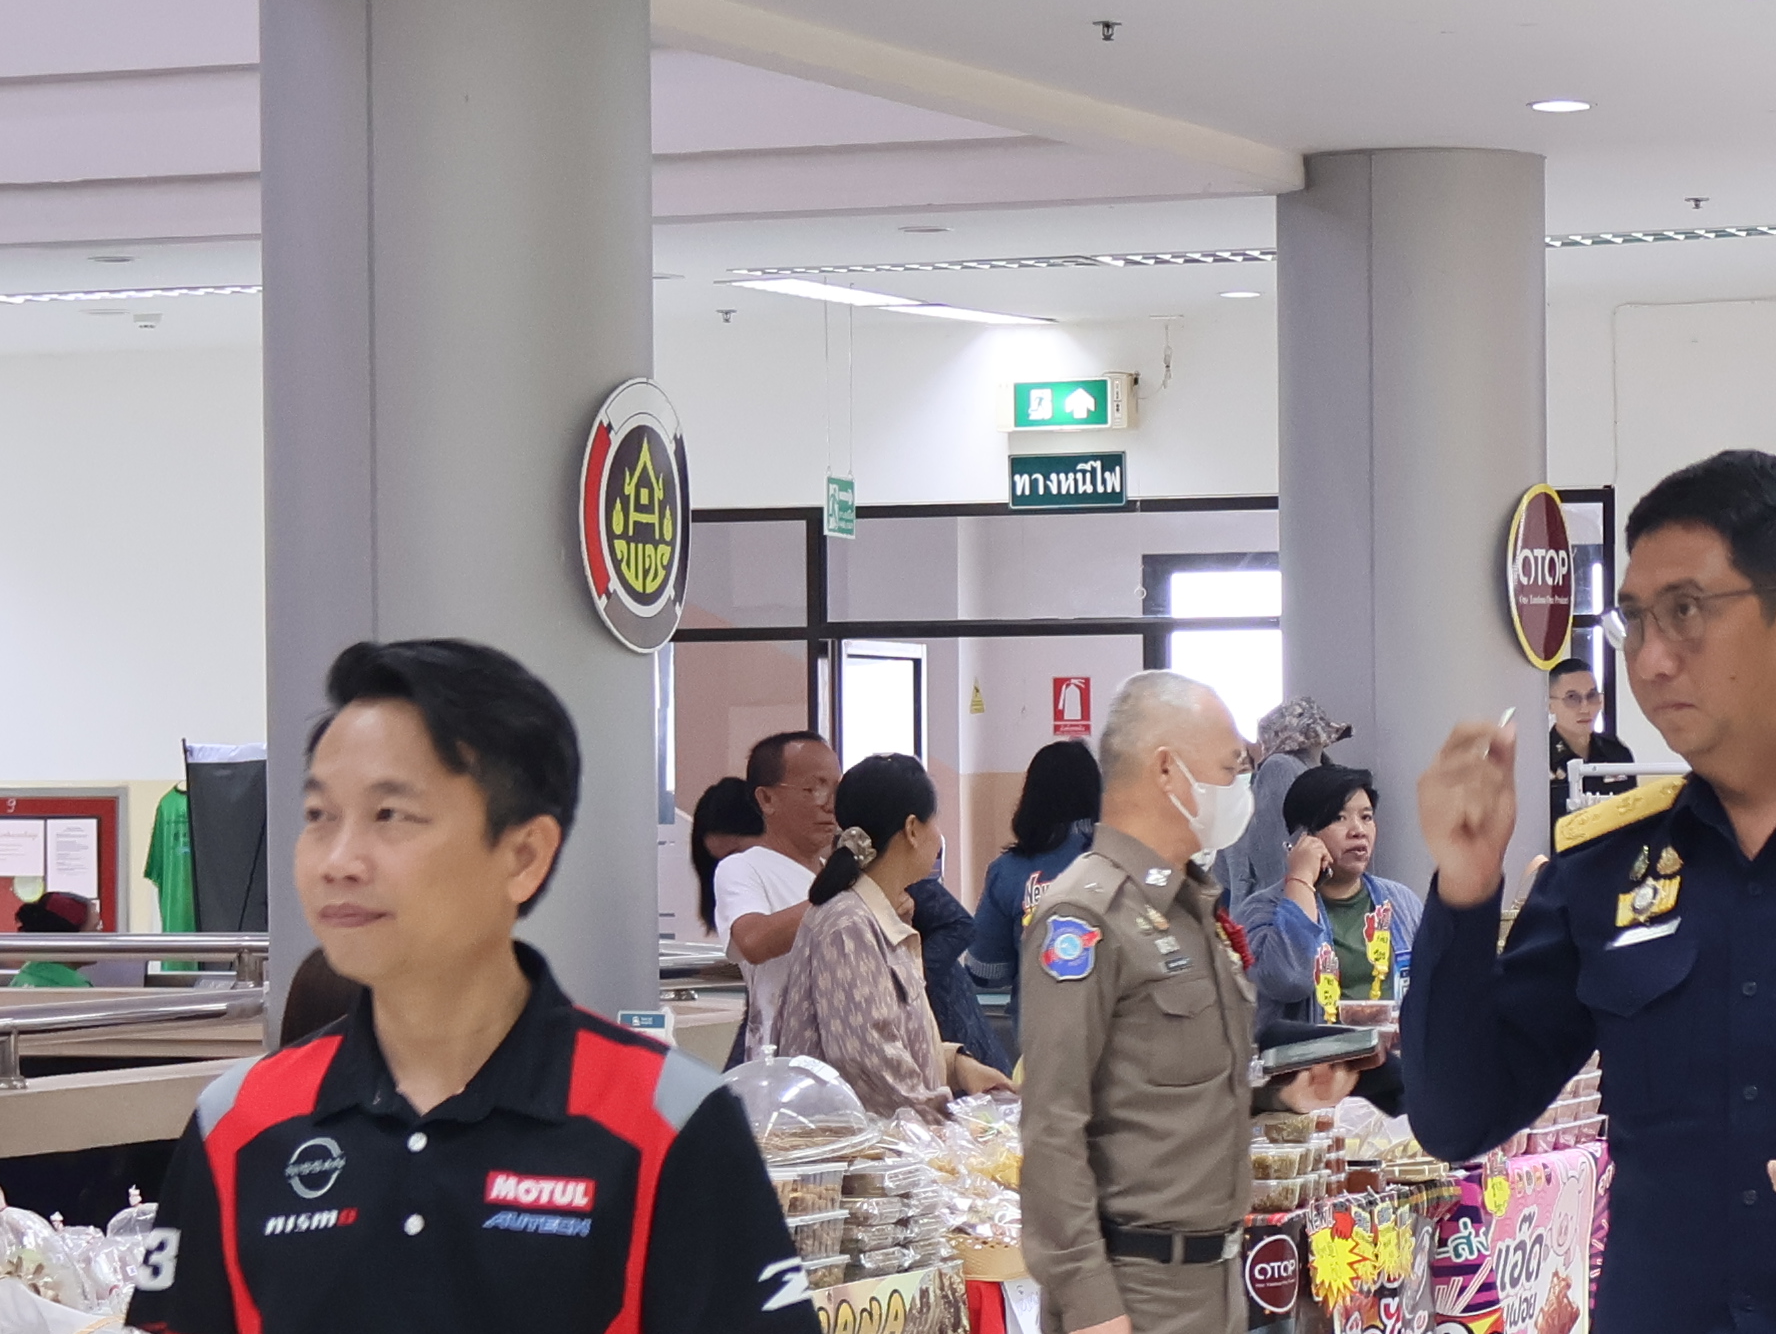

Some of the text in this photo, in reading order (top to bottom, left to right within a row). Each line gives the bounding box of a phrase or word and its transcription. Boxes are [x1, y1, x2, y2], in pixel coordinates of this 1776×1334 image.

[1013, 460, 1121, 497] ทางหนีไฟ
[1518, 548, 1569, 586] OTOP
[489, 1174, 592, 1208] MOTUL
[1254, 1259, 1296, 1280] OTOP
